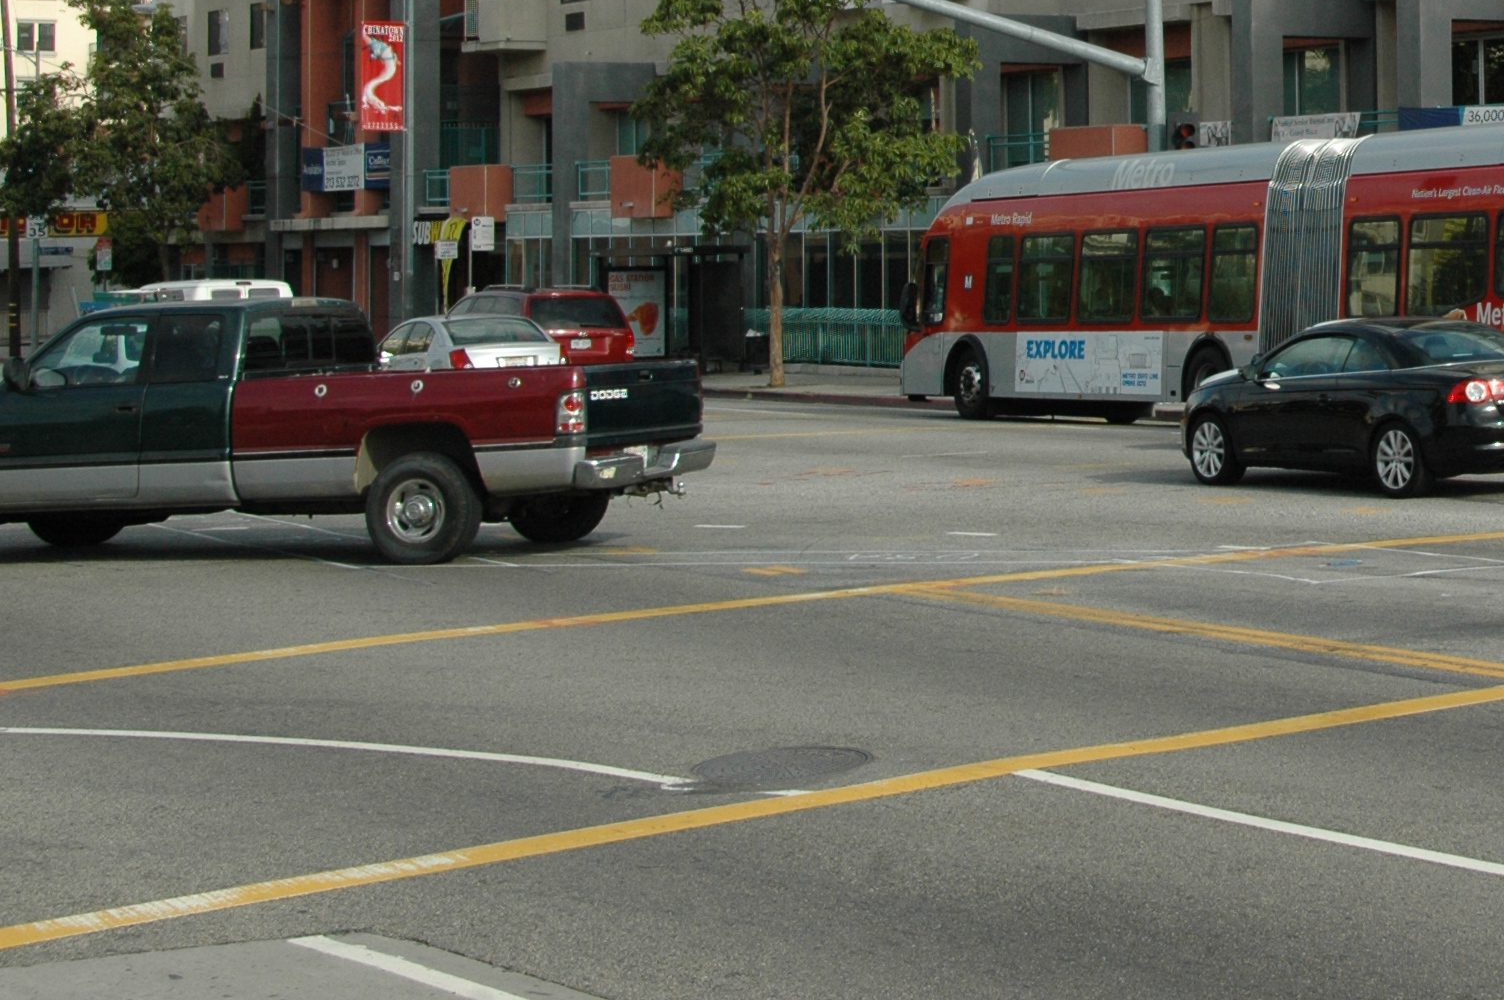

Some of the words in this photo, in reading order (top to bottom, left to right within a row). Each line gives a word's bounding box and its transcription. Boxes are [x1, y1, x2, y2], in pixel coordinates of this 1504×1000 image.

[362, 25, 404, 35] CHINATOWN
[1468, 110, 1504, 124] 36,000
[1112, 159, 1175, 189] Metro
[1411, 188, 1437, 198] Nation's
[1438, 187, 1461, 199] Largest
[991, 213, 1011, 225] Metro
[1012, 212, 1032, 226] Rapid
[29, 227, 46, 237] 35
[1026, 340, 1086, 360] EXPLORE
[590, 389, 628, 401] DODGE
